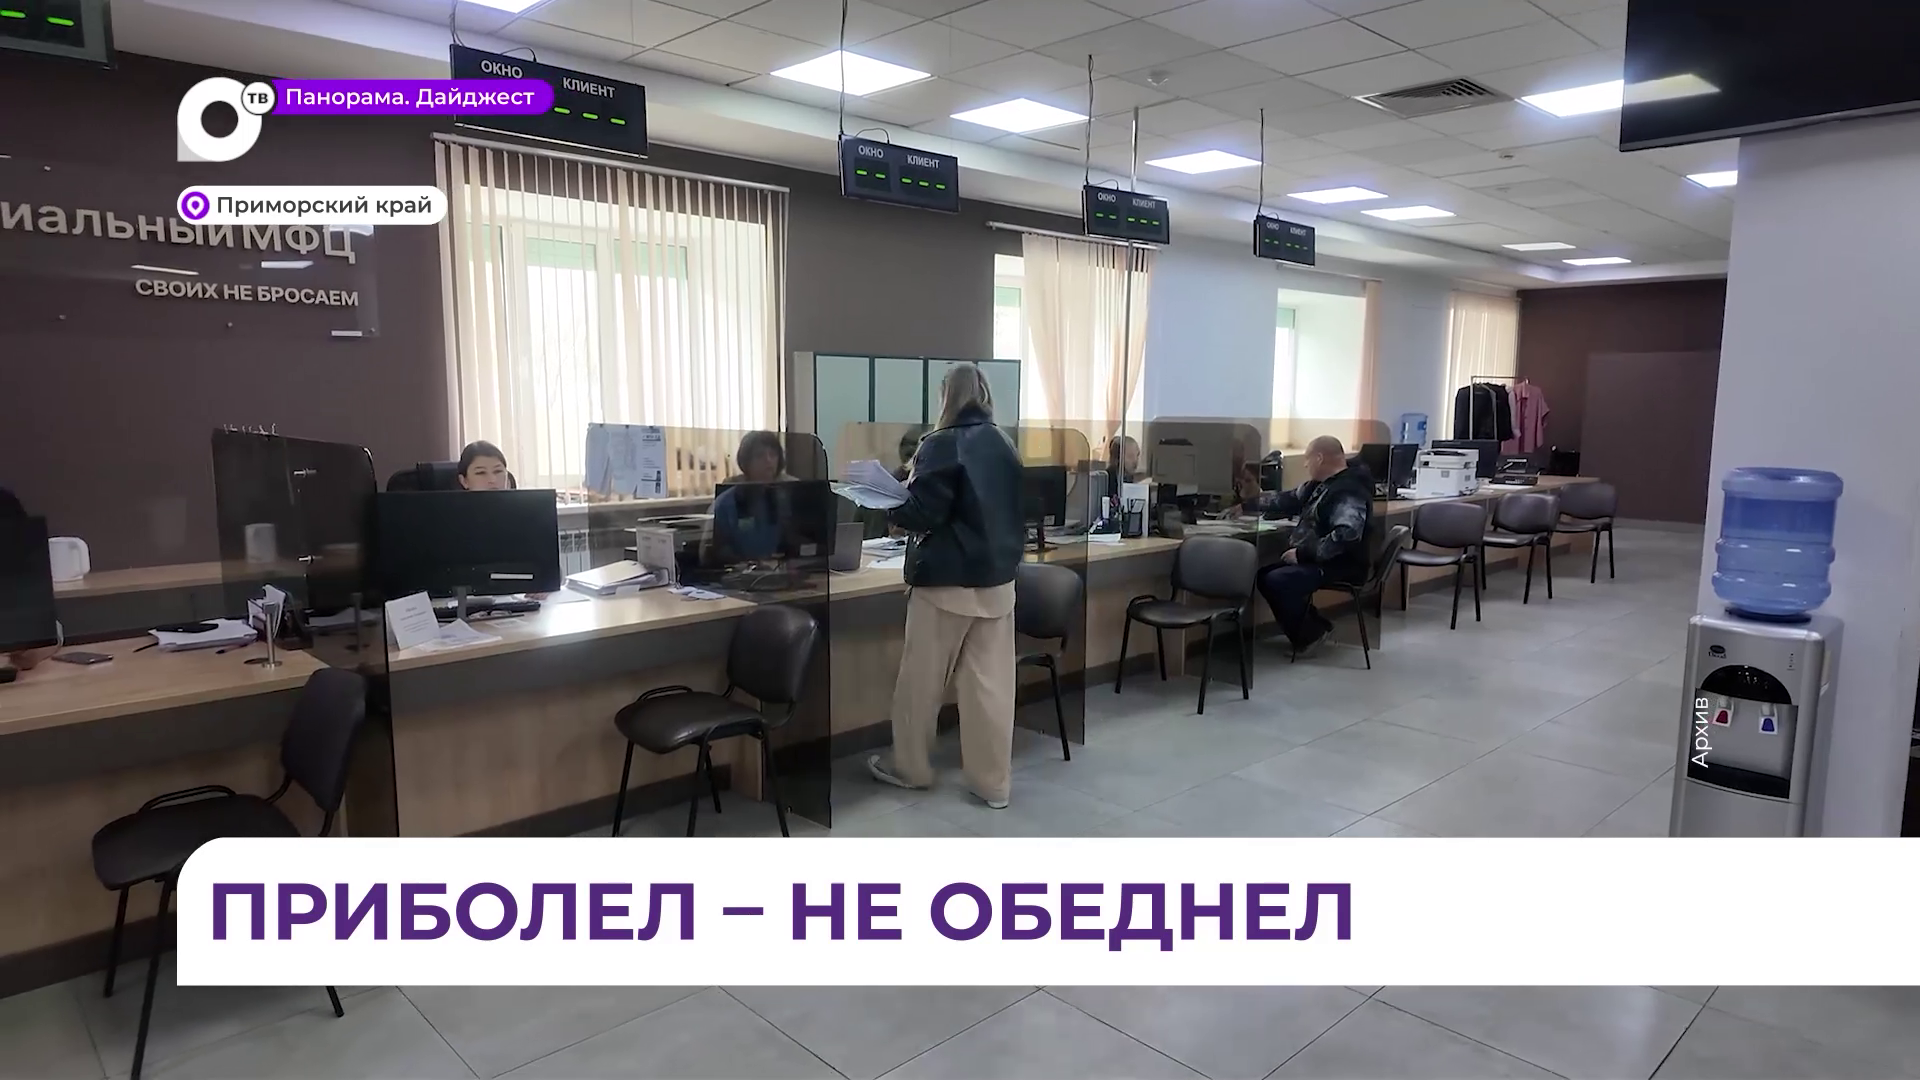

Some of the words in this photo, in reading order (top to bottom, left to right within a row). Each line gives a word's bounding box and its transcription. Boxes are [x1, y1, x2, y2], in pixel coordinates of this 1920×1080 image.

[480, 59, 524, 79] ОКНО
[562, 77, 616, 99] КЛИЕНТ
[858, 145, 884, 159] ОКНО
[907, 154, 940, 169] КЛИЕНТ
[1097, 192, 1117, 203] ОКНО
[1132, 198, 1156, 209] КЛИЕНТ
[242, 224, 356, 265] МФЦ
[135, 278, 218, 300] СВОИХ
[223, 284, 253, 301] НЕ
[257, 286, 359, 307] БРОСАЕМ
